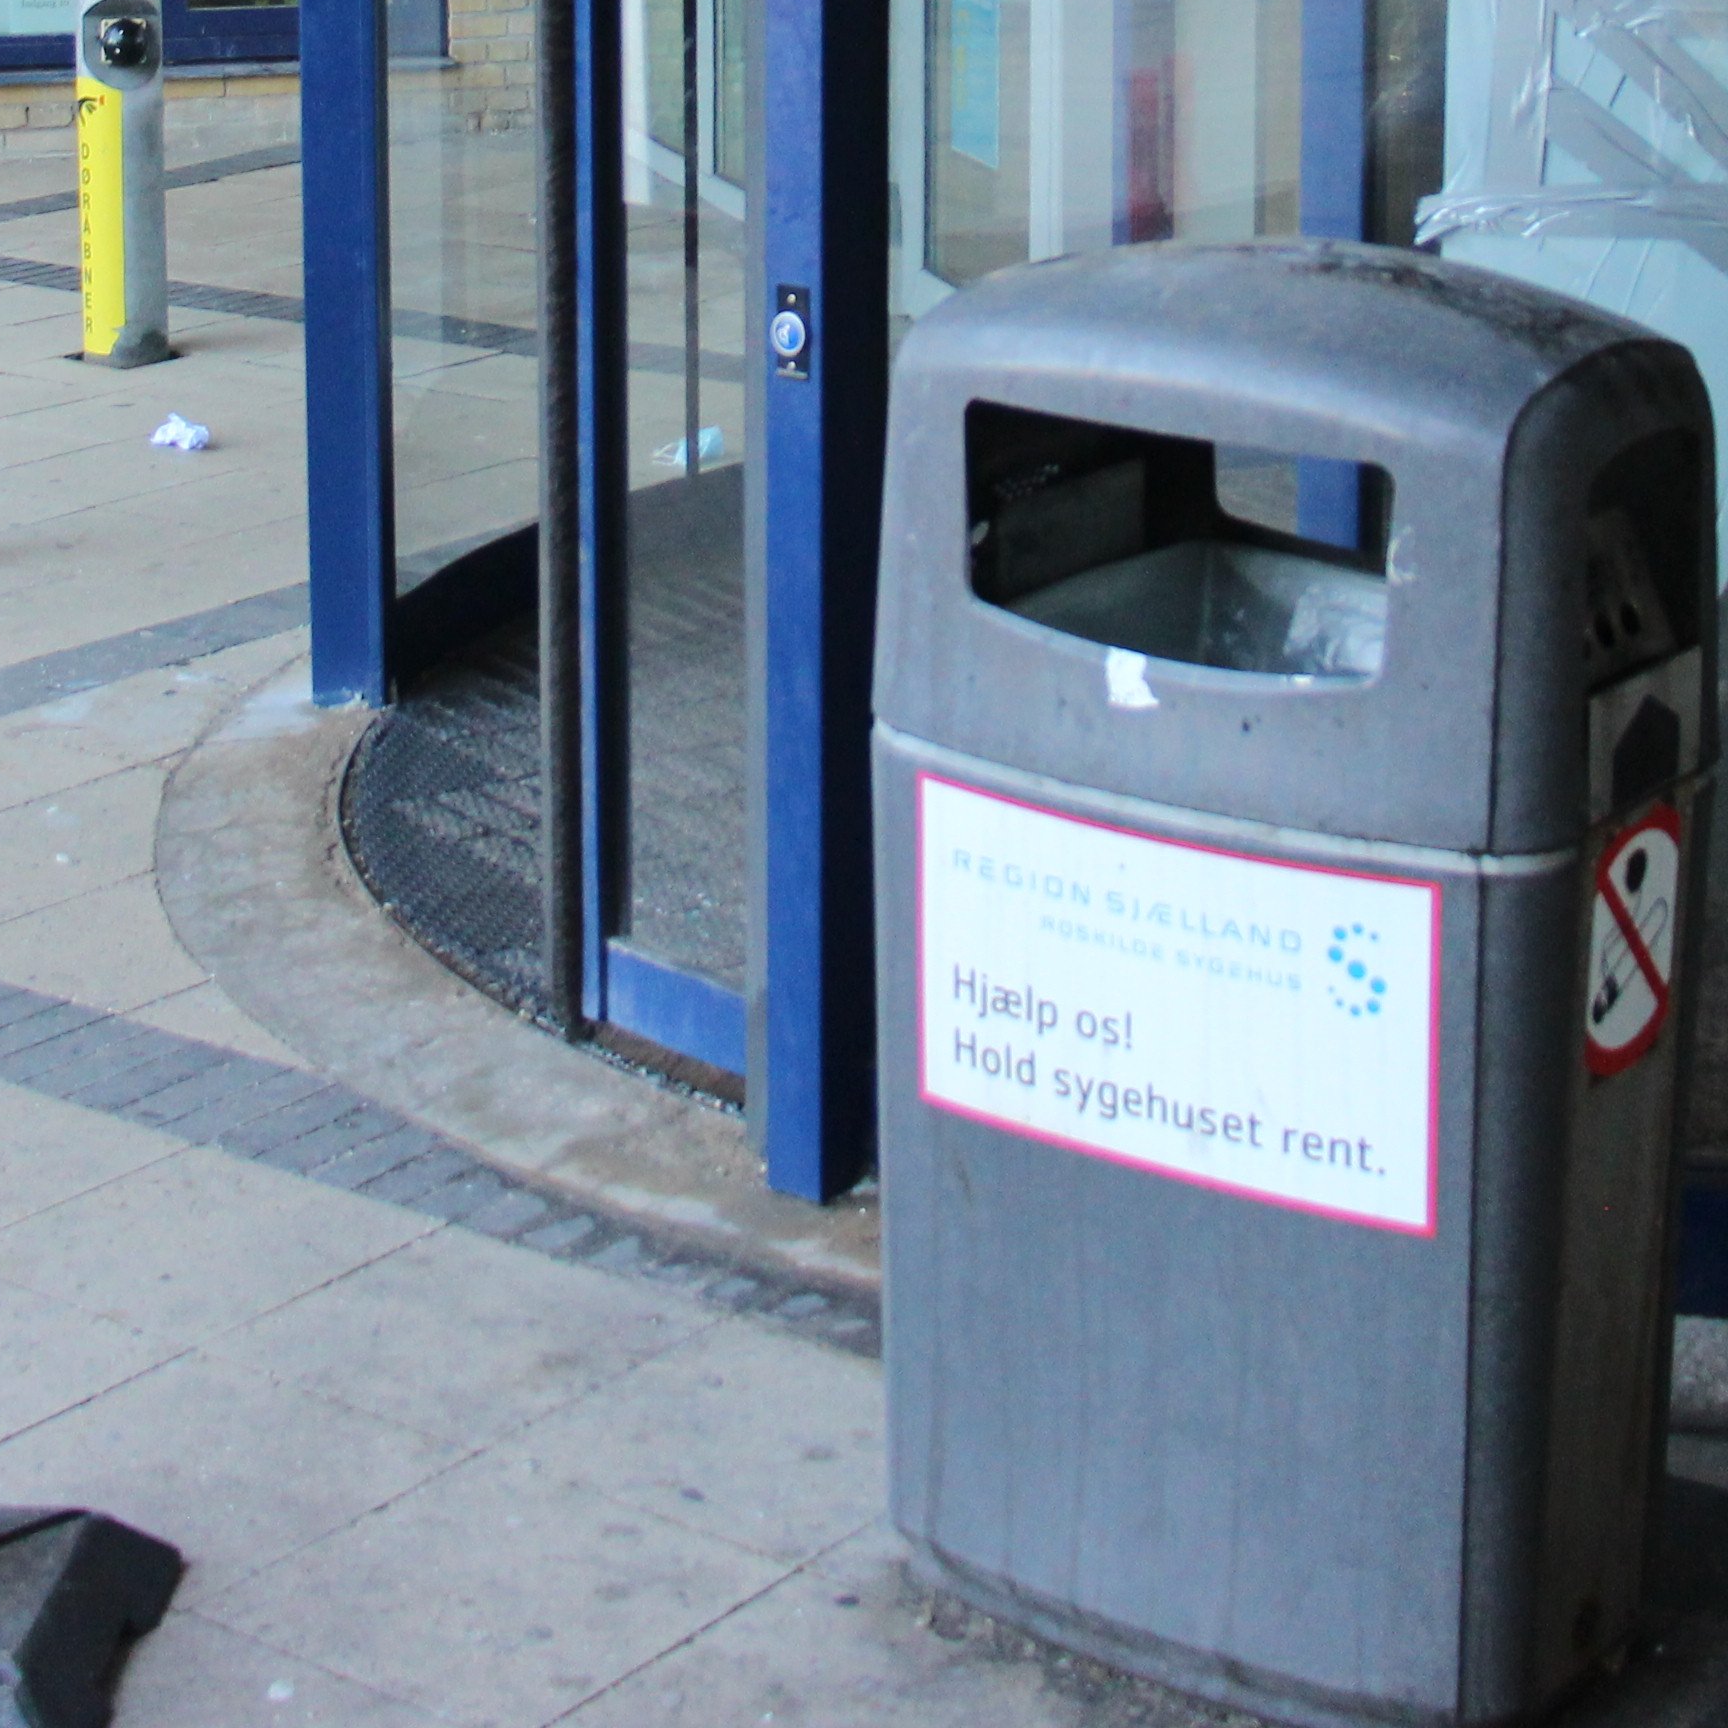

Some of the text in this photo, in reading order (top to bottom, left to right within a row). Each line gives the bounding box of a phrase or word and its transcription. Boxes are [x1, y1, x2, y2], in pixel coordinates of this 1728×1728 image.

[951, 847, 1304, 955] REGION SJÆLLAND
[1039, 913, 1303, 993] ROSKILDE SYGEHUS
[951, 962, 1134, 1051] Hjælp os!
[952, 1026, 1388, 1177] Hold sygehuset rent.
